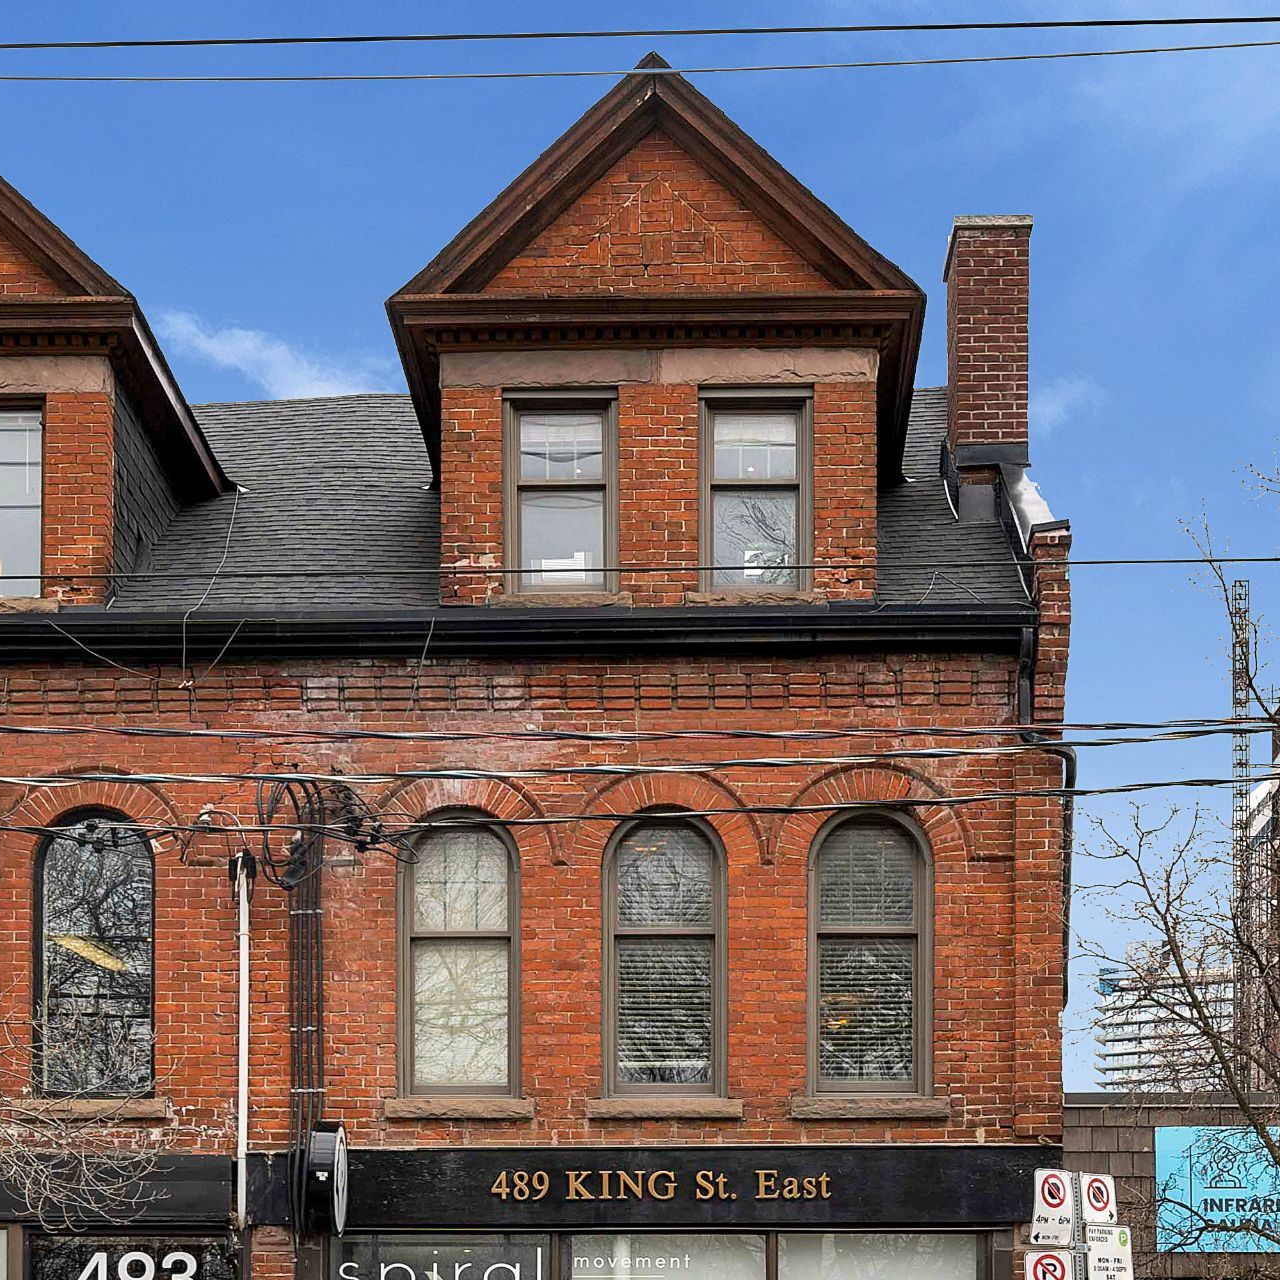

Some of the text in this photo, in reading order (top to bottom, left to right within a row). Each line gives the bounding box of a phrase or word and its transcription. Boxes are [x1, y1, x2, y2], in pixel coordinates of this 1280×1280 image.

[491, 1169, 832, 1201] 489 KING St. East
[1036, 1214, 1048, 1225] 4PM
[1058, 1215, 1070, 1225] 6PM
[573, 1254, 691, 1270] movement
